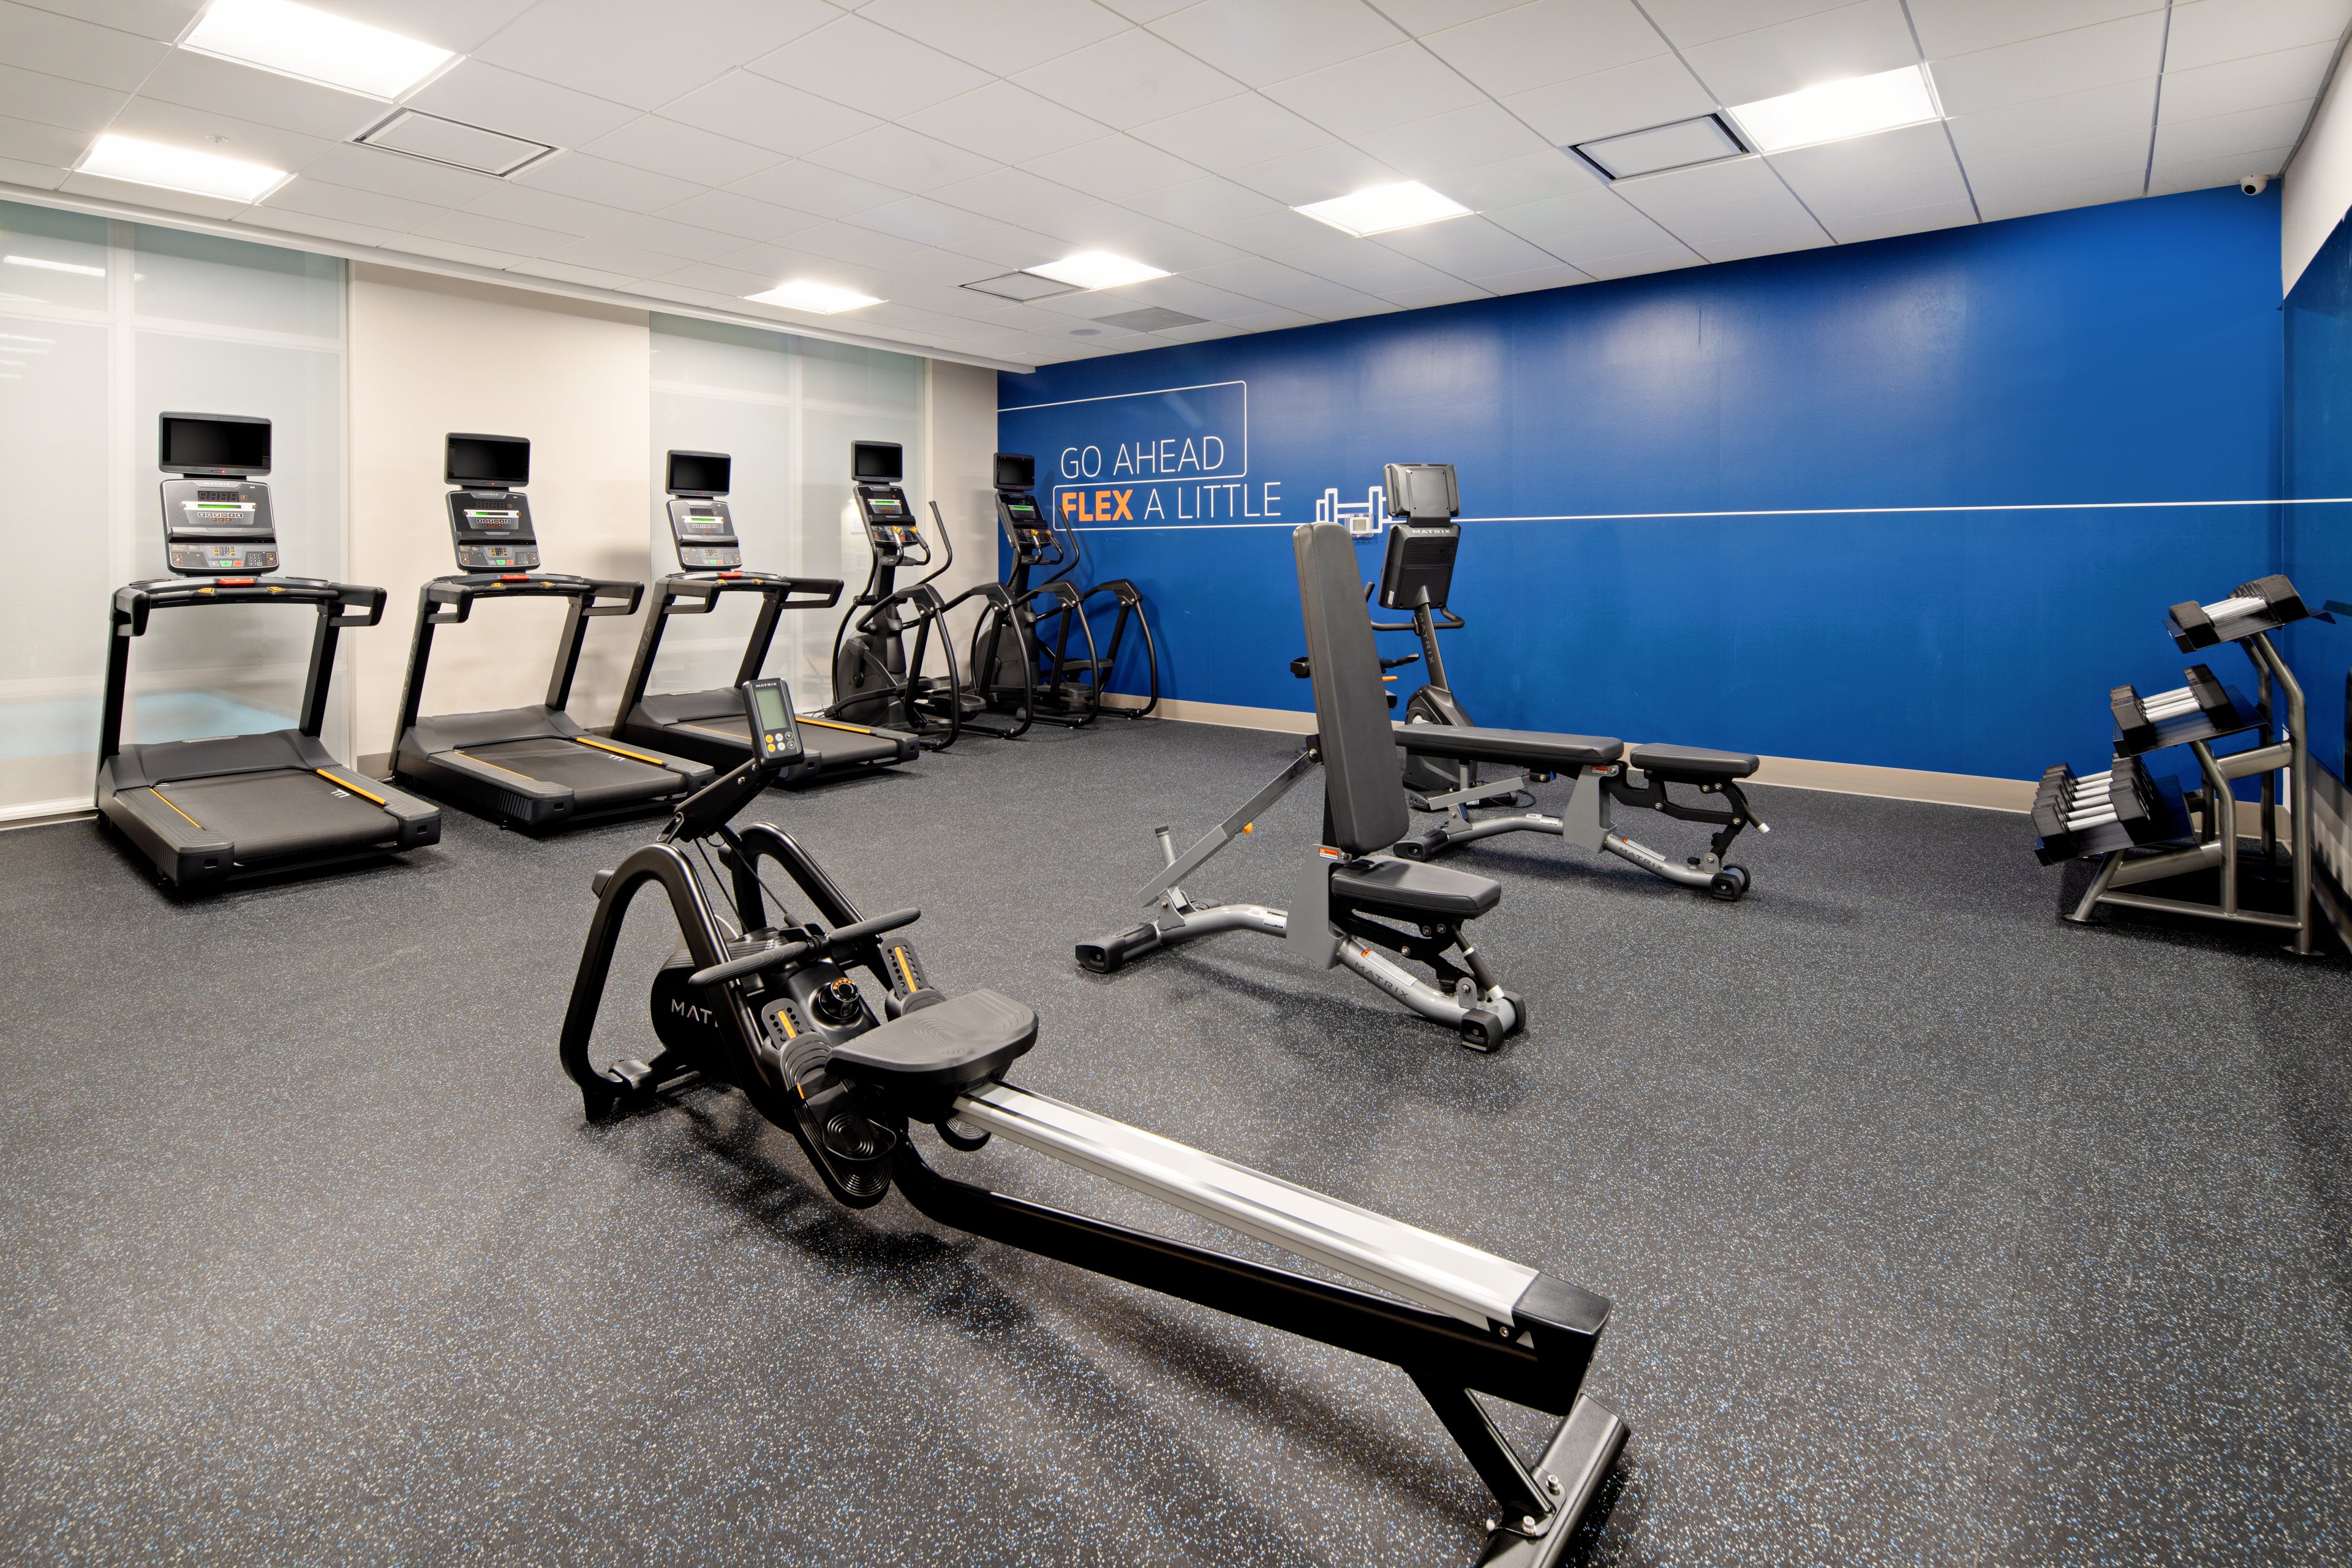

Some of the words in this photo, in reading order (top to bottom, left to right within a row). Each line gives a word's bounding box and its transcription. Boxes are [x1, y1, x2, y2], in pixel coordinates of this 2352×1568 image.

[1060, 445, 1102, 479] GO
[1112, 435, 1224, 476] AHEAD
[1061, 489, 1133, 522] FLEX
[1144, 488, 1165, 520] A
[1178, 481, 1281, 519] LITTLE
[1419, 612, 1434, 665] MATRIX
[1618, 846, 1664, 872] MATRIX
[1354, 961, 1409, 1000] MATRIX
[671, 998, 718, 1028] MAT
